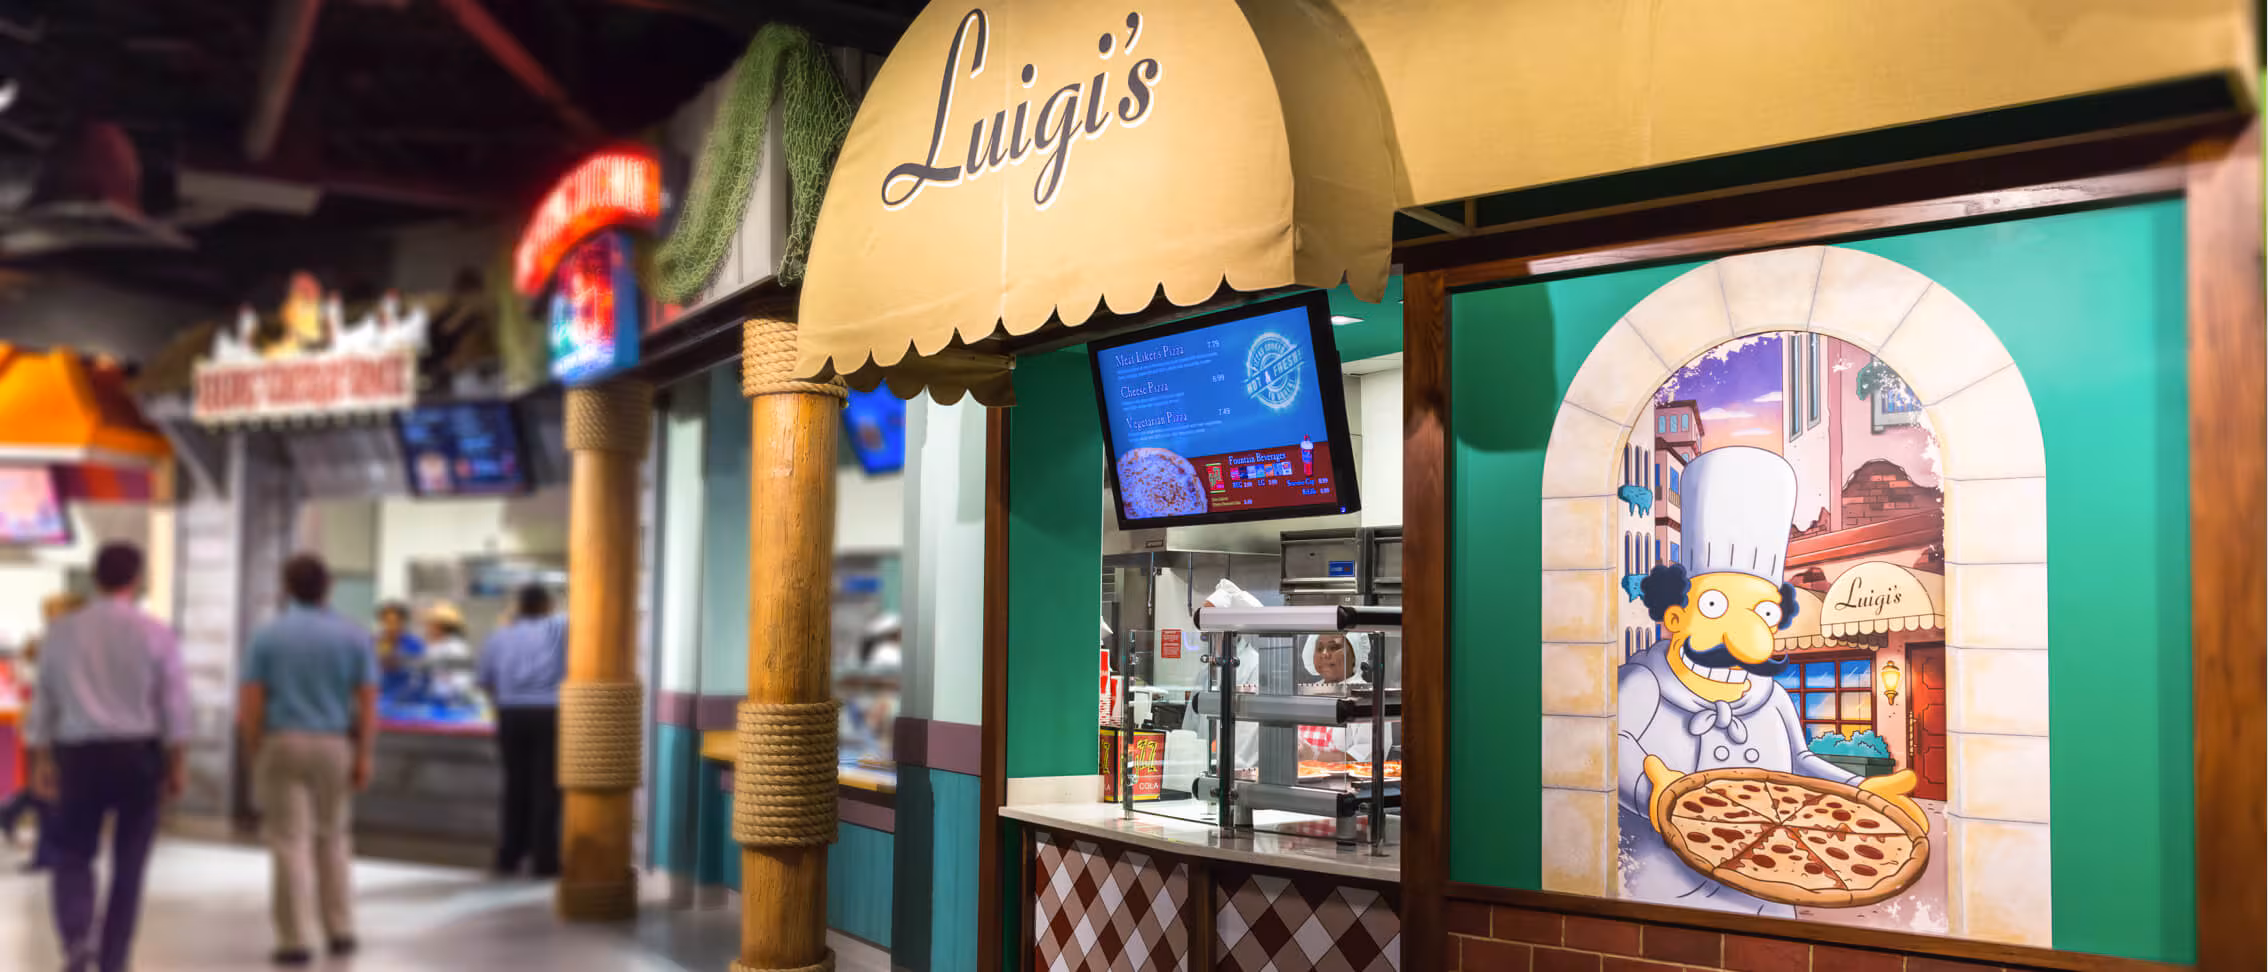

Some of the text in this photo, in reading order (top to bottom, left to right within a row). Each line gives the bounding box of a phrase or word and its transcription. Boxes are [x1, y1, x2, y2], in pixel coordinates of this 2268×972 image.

[882, 8, 1162, 210] Luigi's
[1116, 353, 1134, 368] Meat
[1162, 345, 1184, 358] Pizza
[1120, 387, 1146, 399] Cheese
[1147, 381, 1169, 394] Pizza
[1126, 415, 1166, 433] Vegetarian
[1166, 411, 1188, 424] Pizza
[1228, 451, 1287, 466] Fountain Beverages
[1834, 576, 1902, 615] Luigi's
[1138, 782, 1159, 790] COLA
